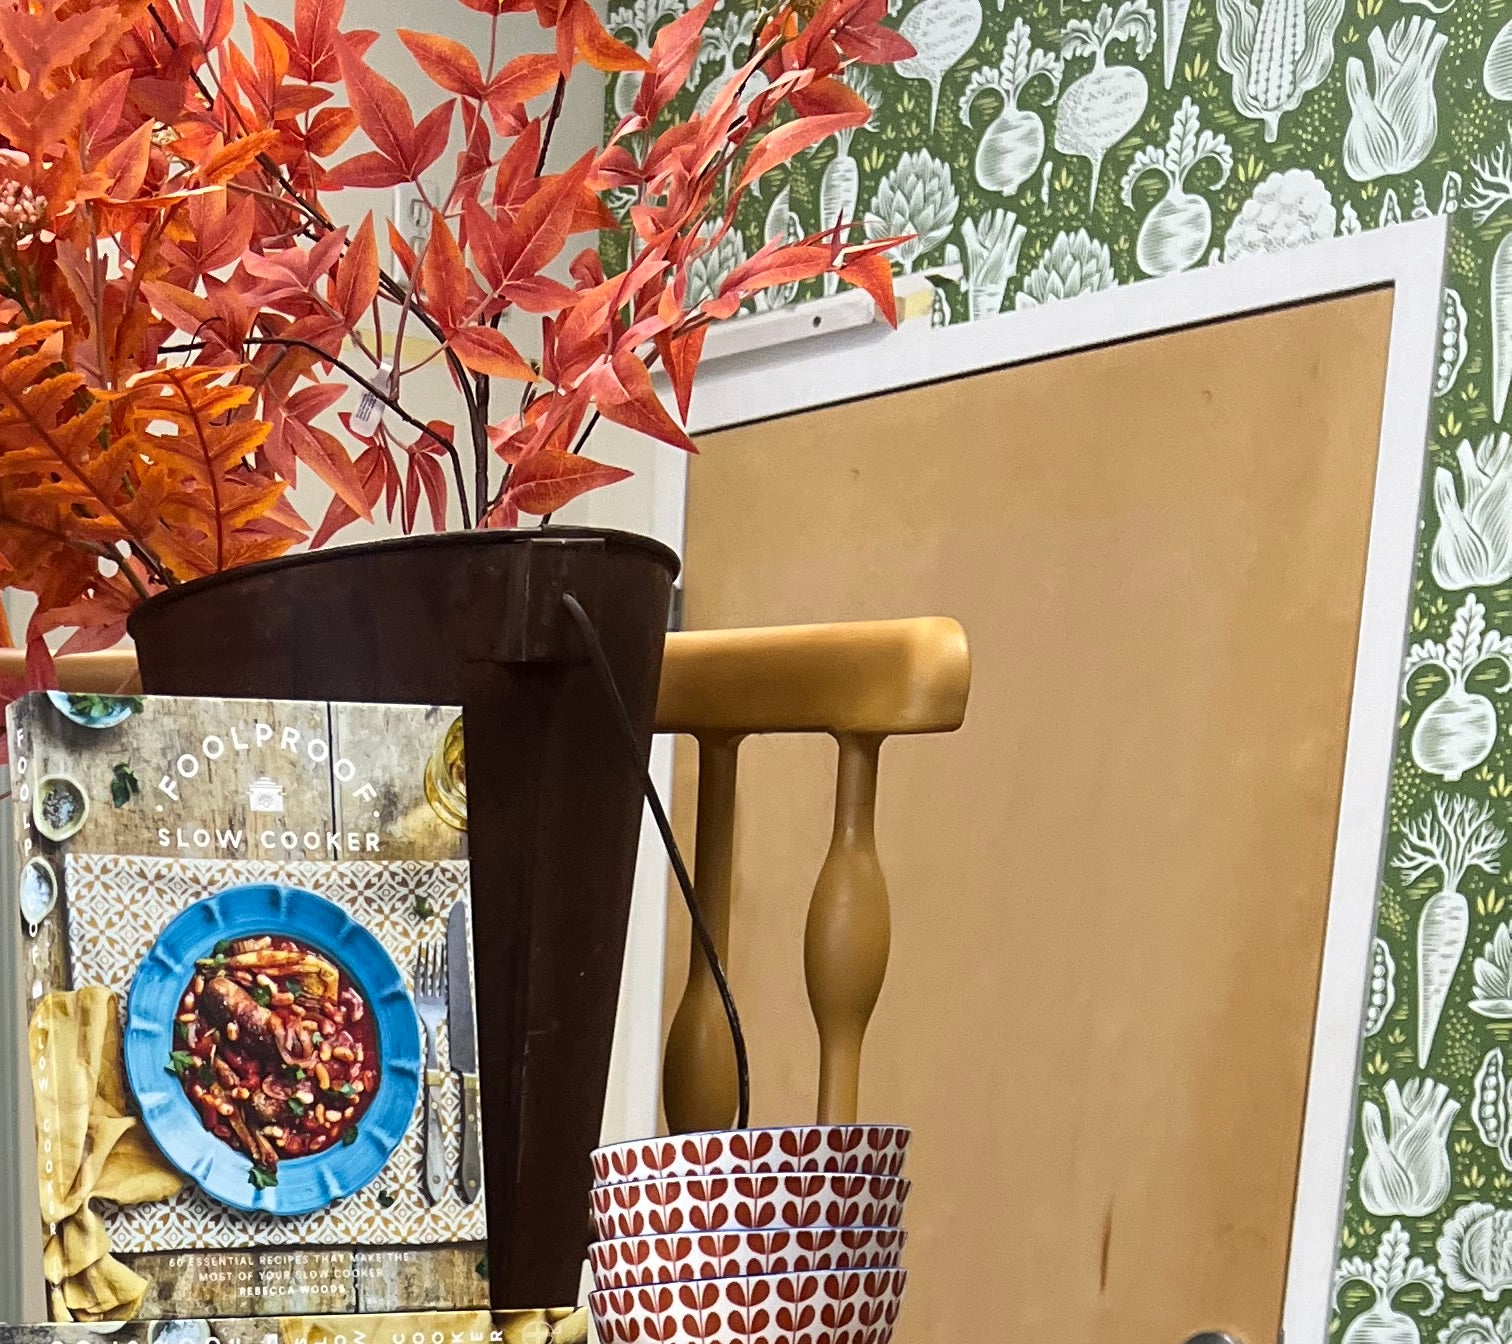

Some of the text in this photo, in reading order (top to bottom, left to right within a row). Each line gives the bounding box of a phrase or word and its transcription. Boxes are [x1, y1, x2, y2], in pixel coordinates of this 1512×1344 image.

[158, 721, 380, 804] FOOLPROOF
[158, 826, 382, 853] SLOW COOKER
[188, 1255, 255, 1268] ESSENTIAL
[259, 1254, 309, 1266] RECIPES
[315, 1253, 346, 1265] THAT
[388, 1252, 410, 1263] THE
[199, 1271, 233, 1283] MOST
[238, 1271, 254, 1282] OF
[258, 1270, 291, 1281] YOUR
[334, 1268, 384, 1280] COOKER
[239, 1284, 347, 1297] REBECCA WOODS
